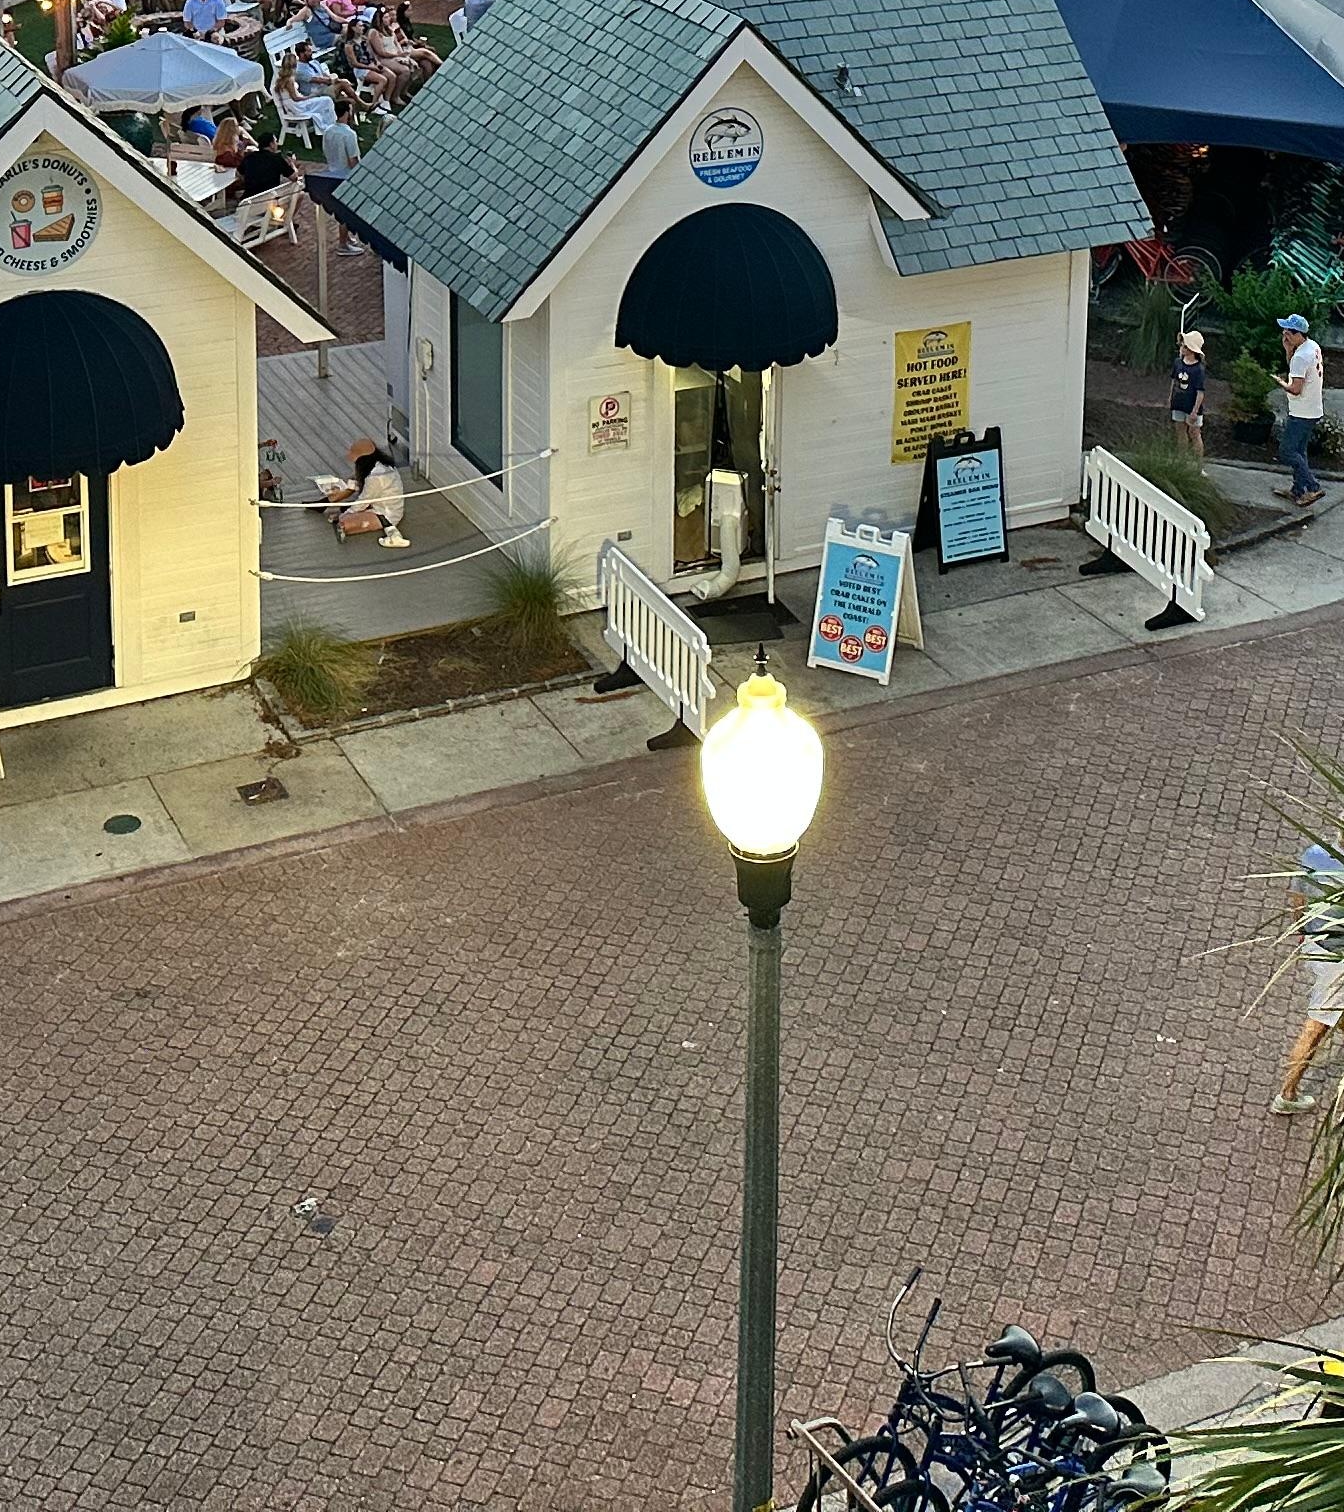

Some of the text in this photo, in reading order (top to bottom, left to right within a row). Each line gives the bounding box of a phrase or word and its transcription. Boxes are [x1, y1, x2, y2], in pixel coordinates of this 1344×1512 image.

[693, 146, 760, 162] REEL EM IN
[42, 159, 88, 187] DONUTS
[699, 164, 753, 177] FRESH SEAFOOD
[4, 254, 47, 271] CHEESE
[50, 256, 59, 268] &
[60, 198, 98, 263] SMOOTHIES
[906, 356, 959, 373] HOT FOOD
[896, 368, 967, 389] SERVED HERE!
[830, 588, 850, 599] CRAB
[820, 622, 843, 636] BEST
[865, 632, 887, 646] BEST
[840, 642, 863, 656] BEST
